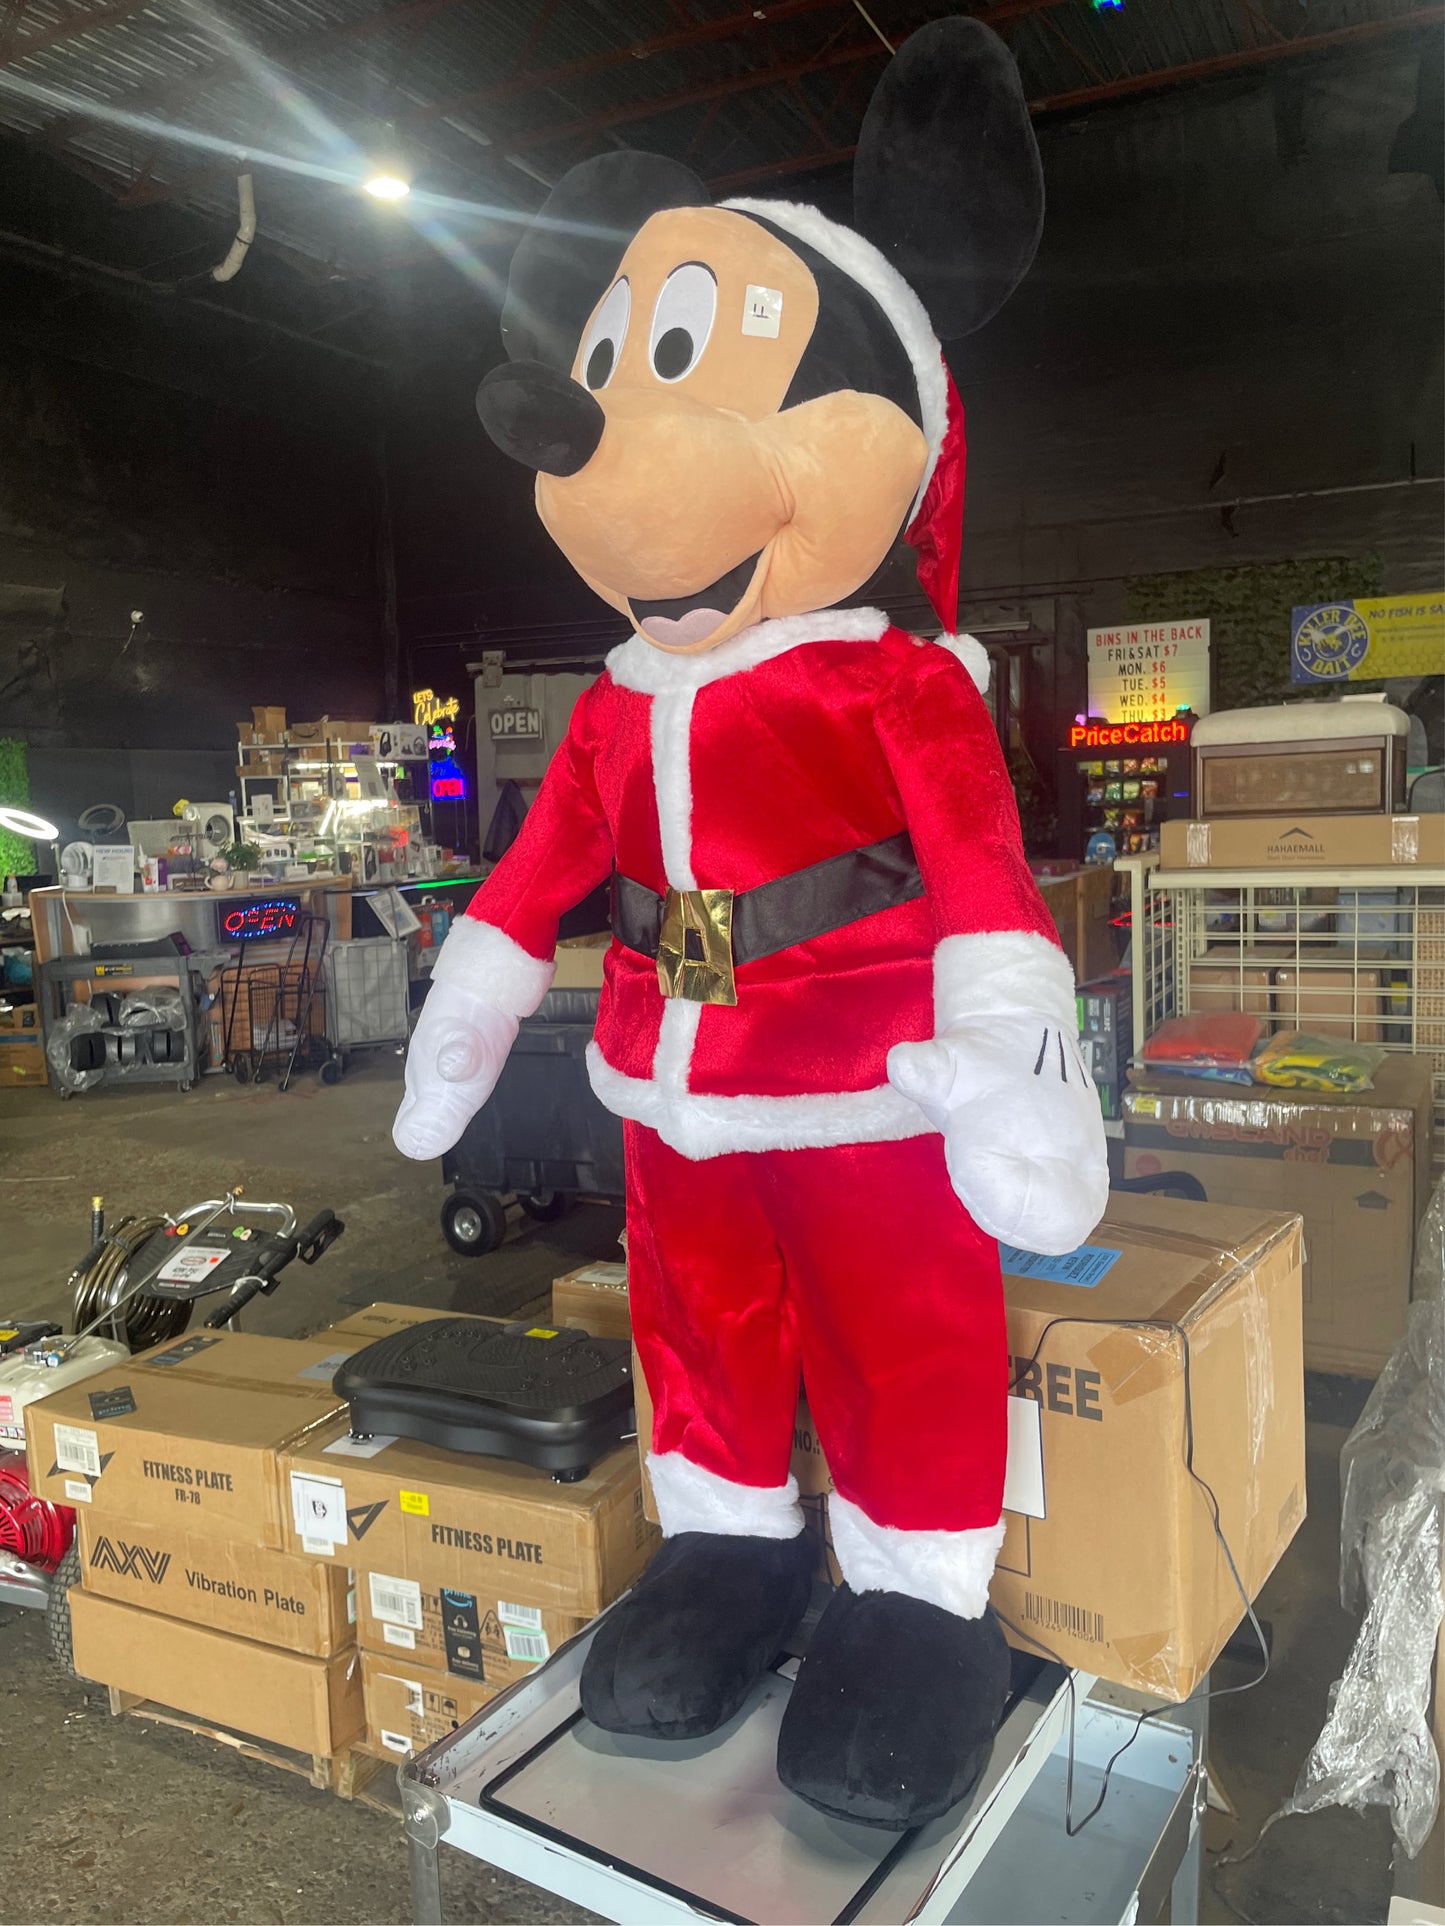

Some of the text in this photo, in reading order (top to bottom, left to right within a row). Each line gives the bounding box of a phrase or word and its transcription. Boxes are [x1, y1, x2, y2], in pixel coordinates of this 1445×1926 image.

[1369, 609, 1385, 619] NO
[1388, 607, 1412, 619] FISH
[1416, 606, 1426, 616] IS
[1096, 626, 1202, 647] BINS IN THE BACK
[1344, 613, 1367, 641] BEE
[1164, 644, 1178, 656] $7
[1118, 661, 1166, 676] MON. $6
[1311, 654, 1351, 674] BAIT
[1122, 677, 1166, 691] TUE. $5
[1120, 692, 1166, 707] WED. $4
[491, 711, 539, 734] OPEN
[1122, 708, 1166, 722] THU. $3
[1070, 720, 1188, 747] PriceCatch
[1267, 843, 1326, 853] HAHAEMALL
[225, 907, 295, 932] OPEN
[1008, 1355, 1103, 1422] REE
[143, 1460, 233, 1492] FITNESS PLATE
[175, 1488, 201, 1505] FR-78
[432, 1524, 543, 1564] FITNESS PLATE
[185, 1568, 305, 1615] Vibration Plate
